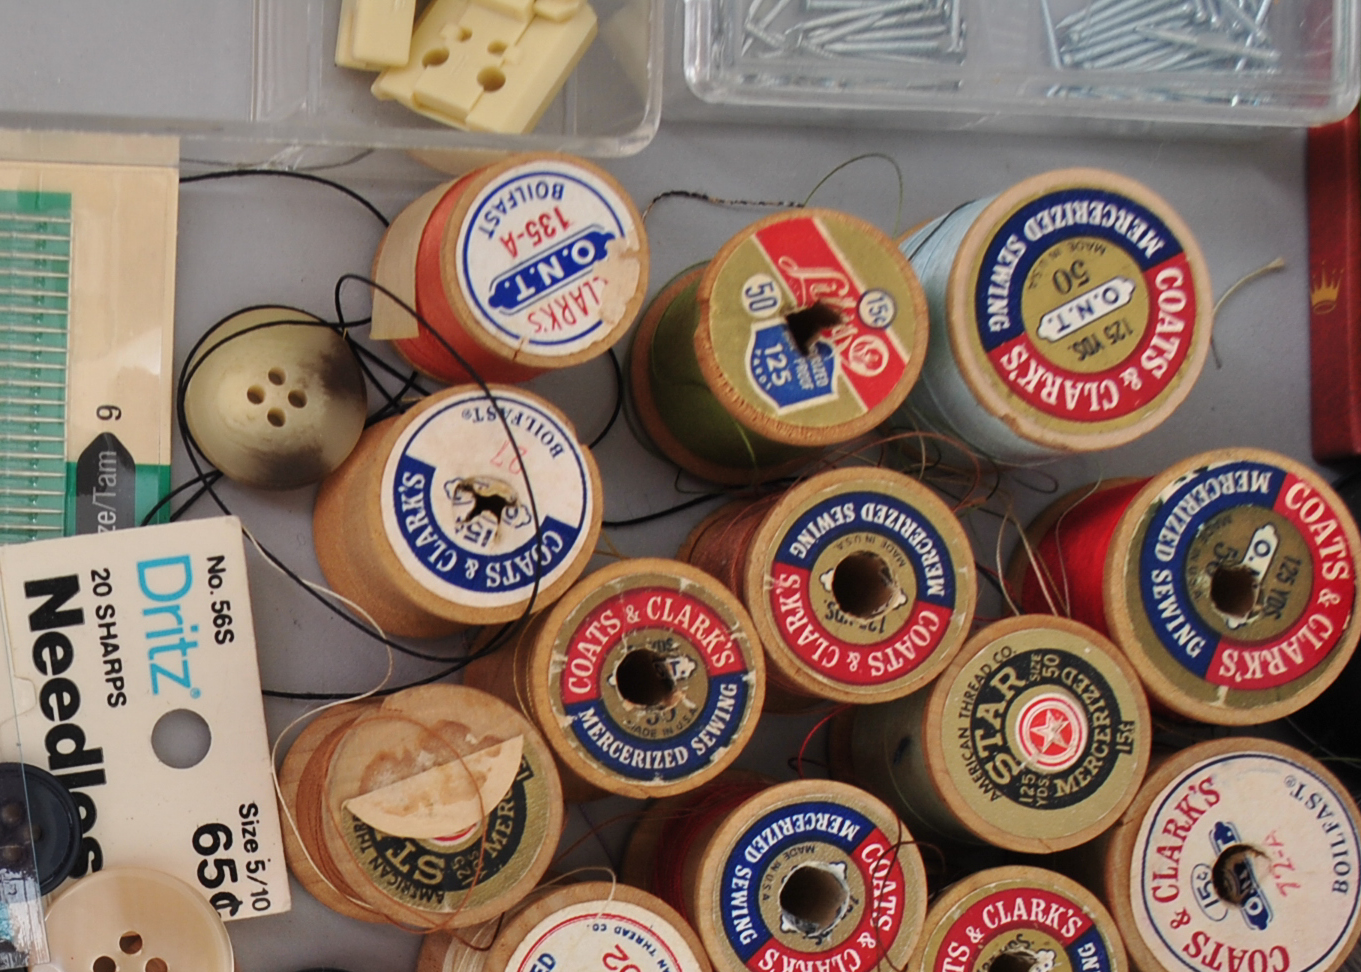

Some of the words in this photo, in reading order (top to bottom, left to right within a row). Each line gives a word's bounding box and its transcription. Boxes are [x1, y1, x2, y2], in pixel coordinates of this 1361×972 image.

[477, 180, 566, 240] BOILFAST
[499, 205, 571, 259] 135-A
[1022, 199, 1167, 260] MERCERIZED
[503, 238, 596, 302] O.N.T.
[1069, 239, 1107, 256] MADE
[744, 281, 779, 314] 50
[987, 233, 1028, 333] SEWING
[1051, 258, 1091, 296] 50
[1046, 286, 1121, 334] O.N.T.
[1104, 317, 1135, 346] 125
[1140, 265, 1188, 381] COATS
[764, 343, 793, 387] 125
[999, 343, 1121, 412] CLARK'S
[1118, 366, 1143, 392] &
[95, 403, 122, 422] 9
[98, 449, 118, 535] ze/Tam
[1154, 469, 1275, 562] MERCERIZED
[397, 471, 459, 573] CLARK'S
[788, 501, 857, 560] SEWING
[864, 534, 876, 544] IN
[1284, 481, 1350, 580] COATS
[207, 554, 227, 595] No.
[464, 557, 480, 580] &
[485, 529, 564, 588] COATS
[860, 502, 946, 598] MERCERIZED
[882, 540, 909, 568] MADE
[1276, 554, 1302, 586] 125
[90, 567, 114, 598] 20
[1317, 587, 1342, 608] &
[211, 599, 235, 645] 56S
[774, 572, 841, 669] CLARK'S
[1151, 568, 1208, 660] SEWING
[95, 604, 128, 708] SHARPS
[568, 607, 622, 695] COATS
[624, 604, 641, 624] &
[645, 595, 736, 669] CLARK'S
[845, 651, 861, 673] &
[867, 609, 940, 678] COATS
[992, 644, 1018, 665] CO.
[1029, 652, 1043, 682] SIZE
[1042, 653, 1061, 678] 50
[1218, 612, 1335, 683] CLARK'S
[958, 662, 993, 720] THREAD
[577, 706, 689, 770] MERCERIZED
[690, 683, 739, 756] SEWING
[662, 727, 675, 737] IN
[974, 665, 1027, 786] STAR
[1053, 666, 1112, 798] MERCERIZED
[957, 726, 1003, 803] AMERICAN
[1019, 773, 1037, 804] 125
[238, 802, 260, 854] Size
[743, 812, 861, 864] MERCERIZED
[782, 844, 817, 862] MADE
[1150, 776, 1221, 904] CLARK'S
[248, 857, 272, 912] 5/10
[368, 856, 446, 905] AMERICAN
[451, 856, 474, 887] 125
[769, 860, 782, 872] IN
[860, 842, 897, 932] COATS
[1196, 869, 1220, 910] 15¢
[730, 864, 758, 946] SEWING
[964, 924, 985, 944] &
[981, 897, 1084, 939] CLARK'S
[1169, 907, 1192, 930] &
[613, 925, 657, 958] THREAD
[856, 931, 877, 949] &
